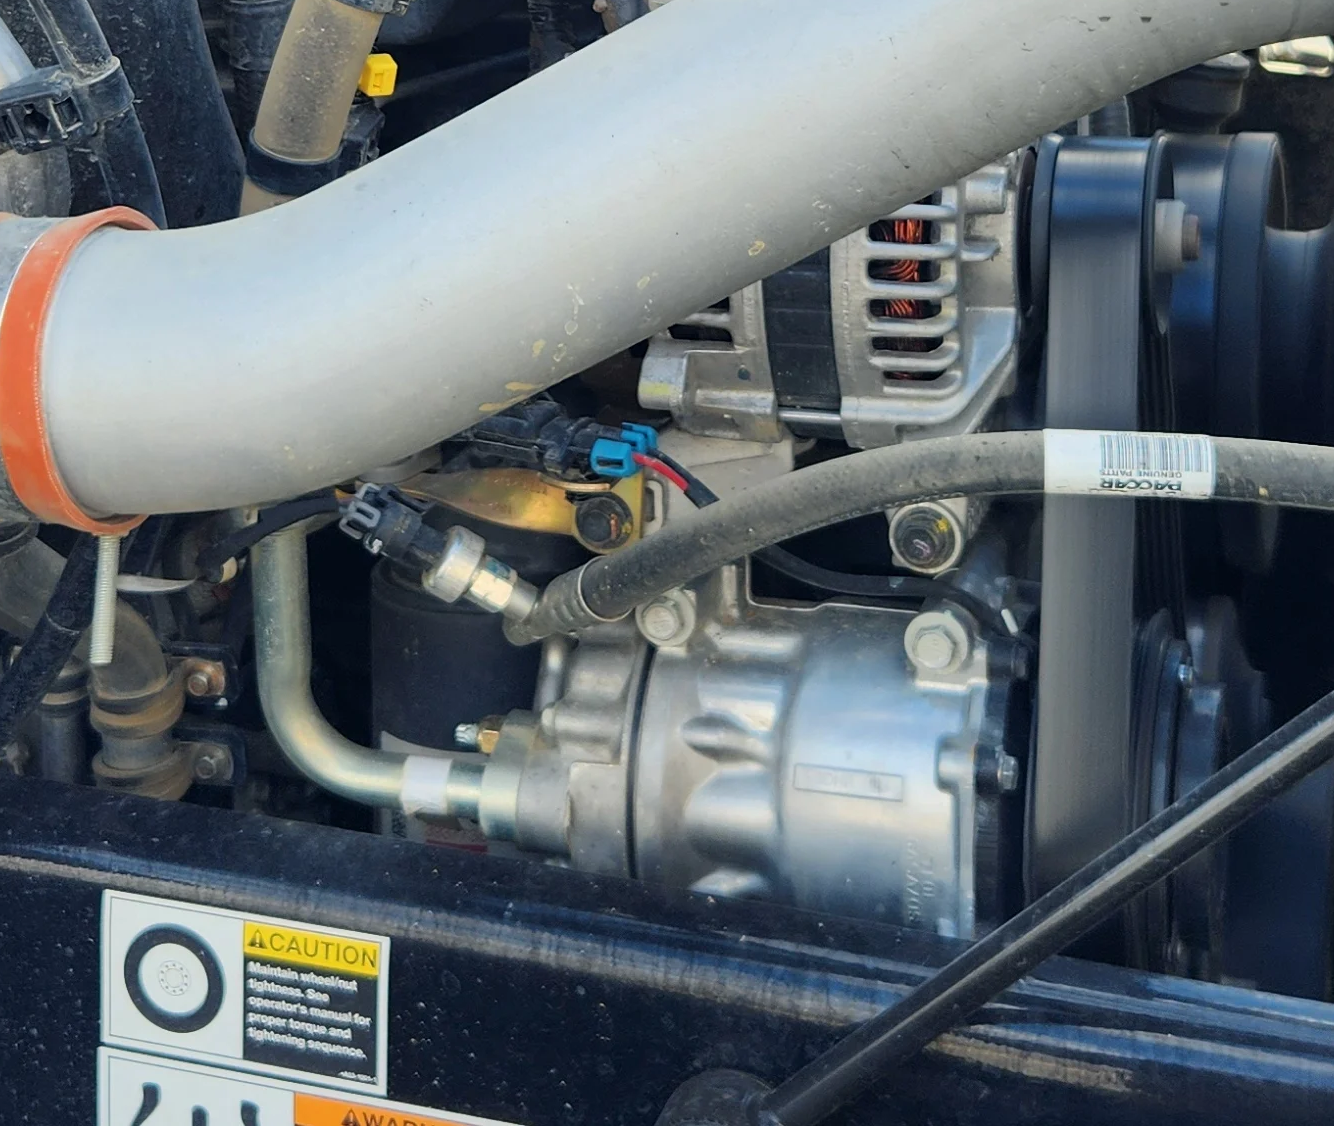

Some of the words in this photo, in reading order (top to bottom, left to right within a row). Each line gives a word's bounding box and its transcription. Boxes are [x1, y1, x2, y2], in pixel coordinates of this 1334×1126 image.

[1099, 469, 1133, 477] PARTS
[1100, 478, 1182, 492] PACCAR
[1138, 471, 1182, 479] GENUINE
[269, 933, 377, 968] CAUTION
[247, 960, 299, 981] Maintain
[300, 972, 358, 991] wheel/nut
[246, 978, 305, 998] tightness.
[305, 988, 330, 1002] See
[247, 996, 308, 1014] operator's
[309, 1007, 352, 1022] manual
[354, 1012, 372, 1025] for
[247, 1012, 288, 1027] proper
[288, 1018, 327, 1035] torque
[328, 1028, 352, 1039] and
[246, 1027, 306, 1049] tightening
[307, 1039, 367, 1060] sequence.
